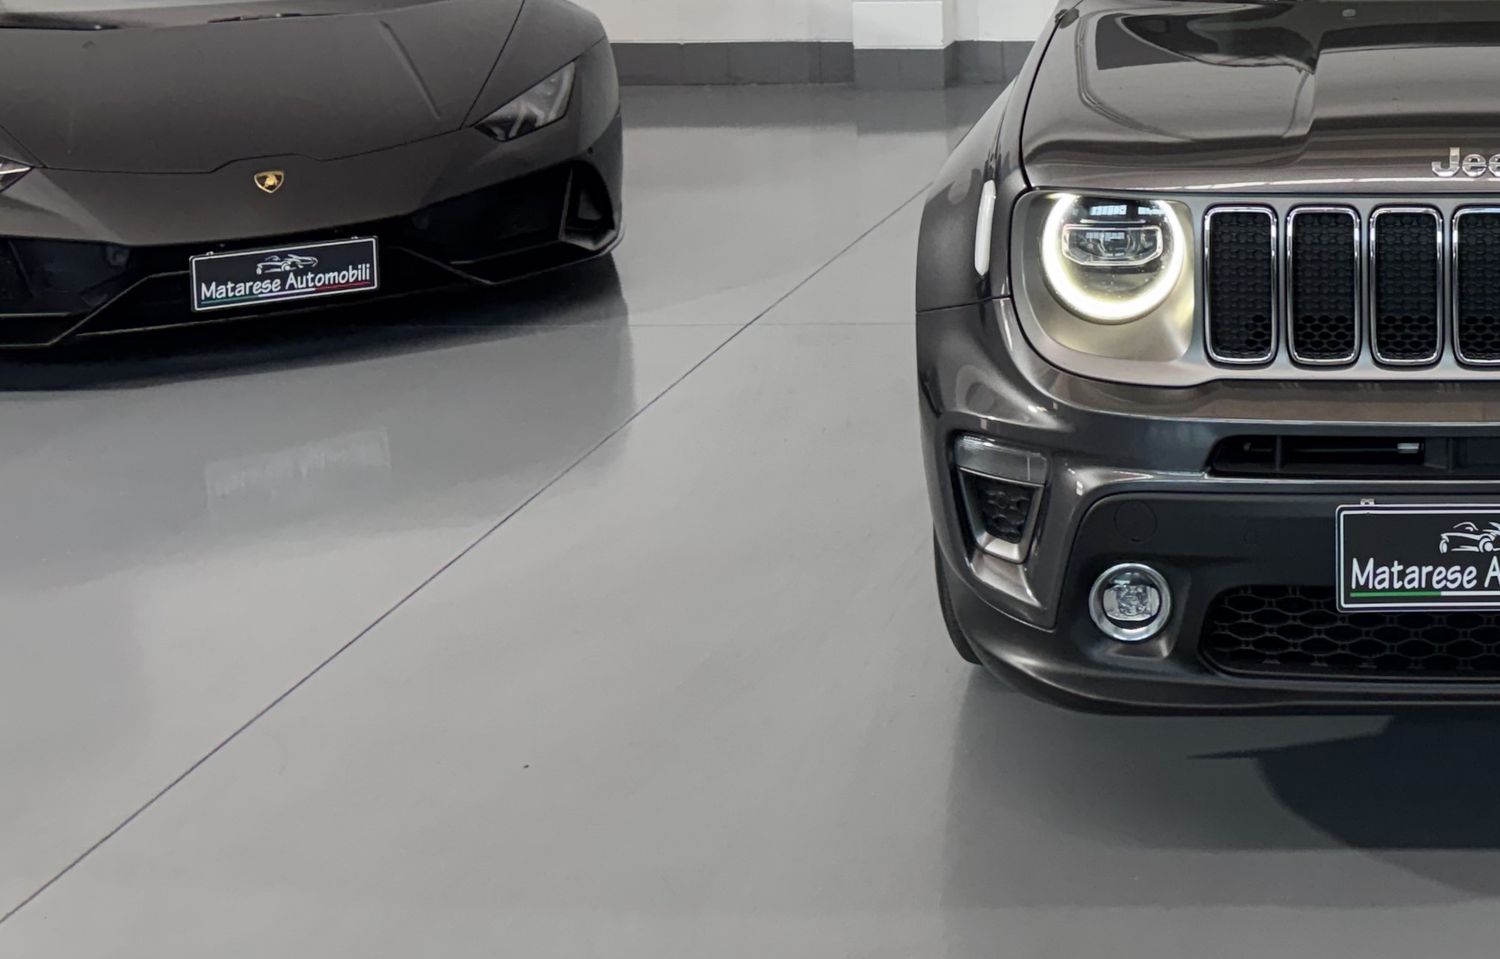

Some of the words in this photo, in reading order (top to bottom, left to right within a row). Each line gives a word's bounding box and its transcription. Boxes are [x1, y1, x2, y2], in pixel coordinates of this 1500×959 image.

[201, 278, 281, 300] Matarese
[285, 263, 370, 290] Automobili
[1351, 557, 1478, 589] Matarese
